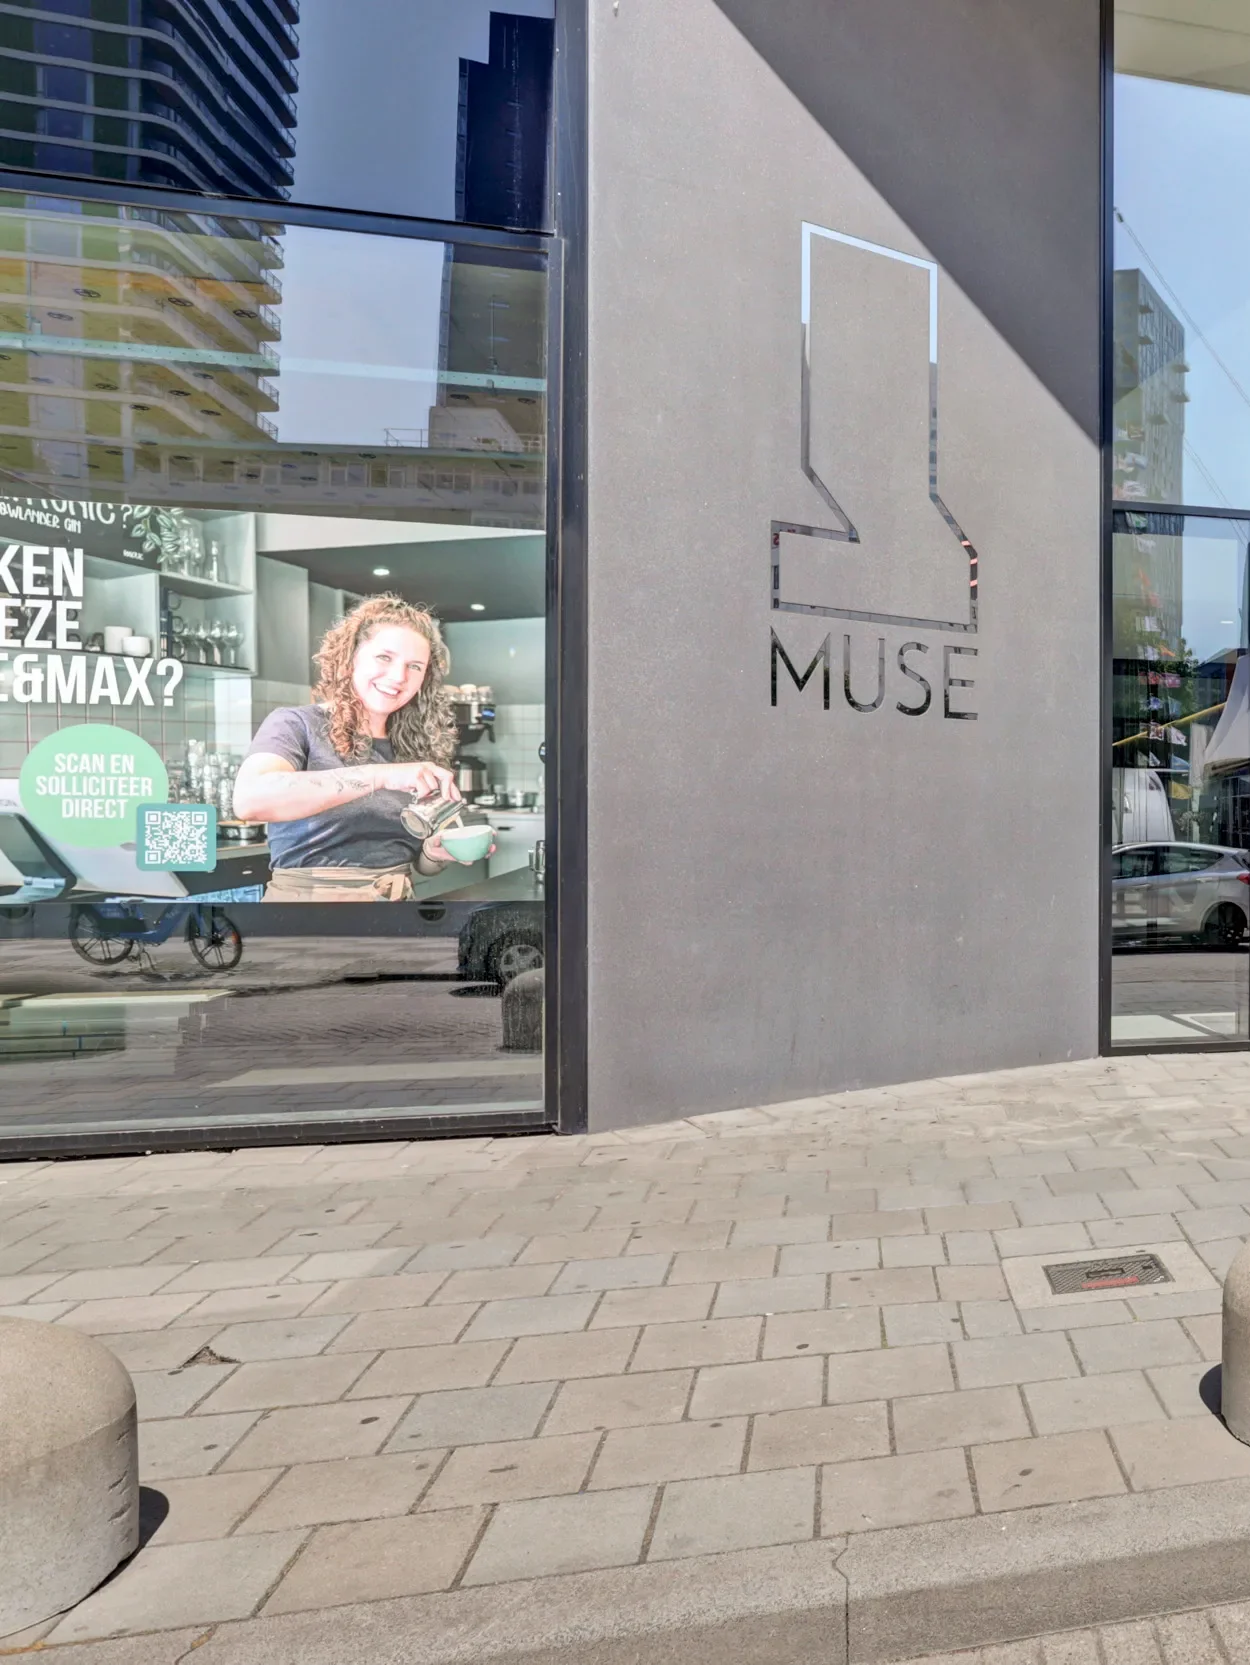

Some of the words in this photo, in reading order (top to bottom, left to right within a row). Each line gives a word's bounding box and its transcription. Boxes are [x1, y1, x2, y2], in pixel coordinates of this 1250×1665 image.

[64, 517, 82, 533] GIN
[770, 624, 978, 720] MUSE
[54, 753, 105, 774] SCAN
[110, 754, 135, 774] EN
[35, 775, 153, 796] SOLLICITEER
[61, 798, 129, 818] DIRECT
